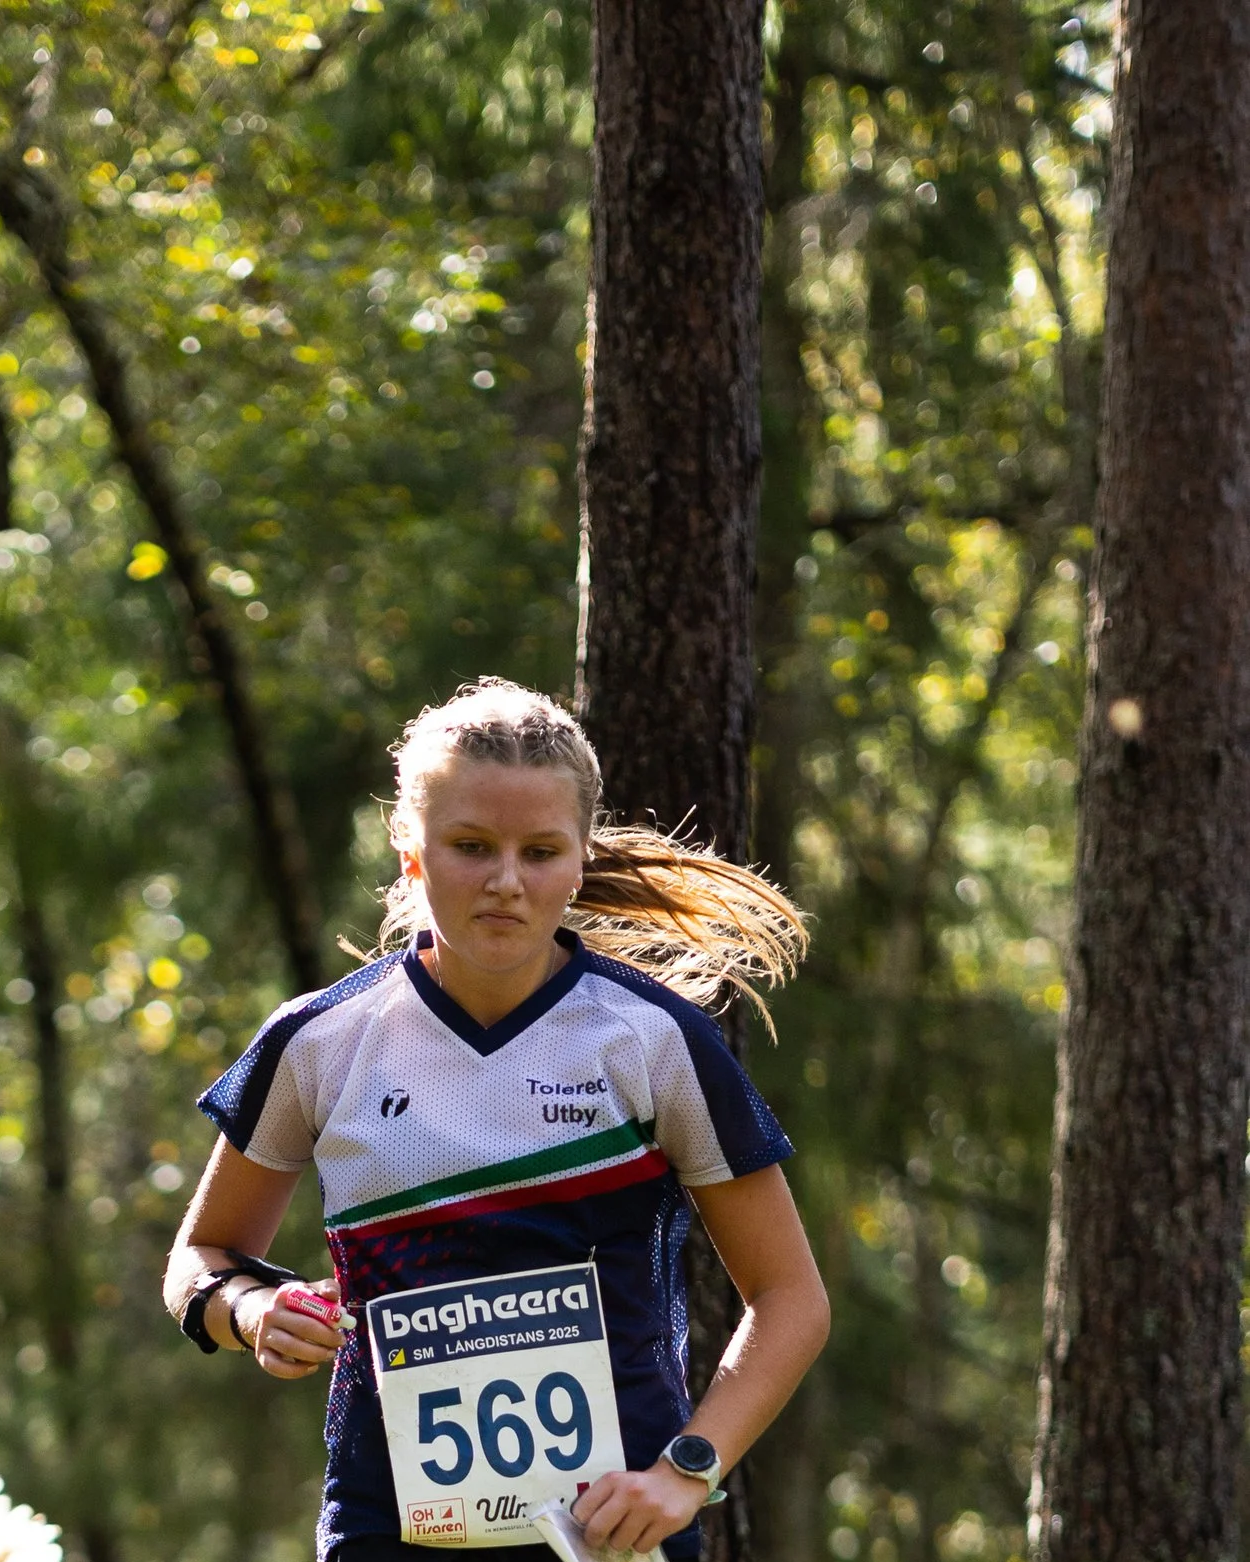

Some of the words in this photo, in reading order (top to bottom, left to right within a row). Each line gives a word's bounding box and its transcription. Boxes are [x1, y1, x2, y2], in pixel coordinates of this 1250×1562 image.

[542, 1103, 598, 1128] Utby
[381, 1283, 590, 1340] bagheera
[412, 1346, 435, 1362] SM
[445, 1330, 546, 1356] LÅNGDISTANS
[548, 1325, 581, 1341] 2025
[417, 1371, 593, 1486] 569
[413, 1521, 463, 1536] Tisaren
